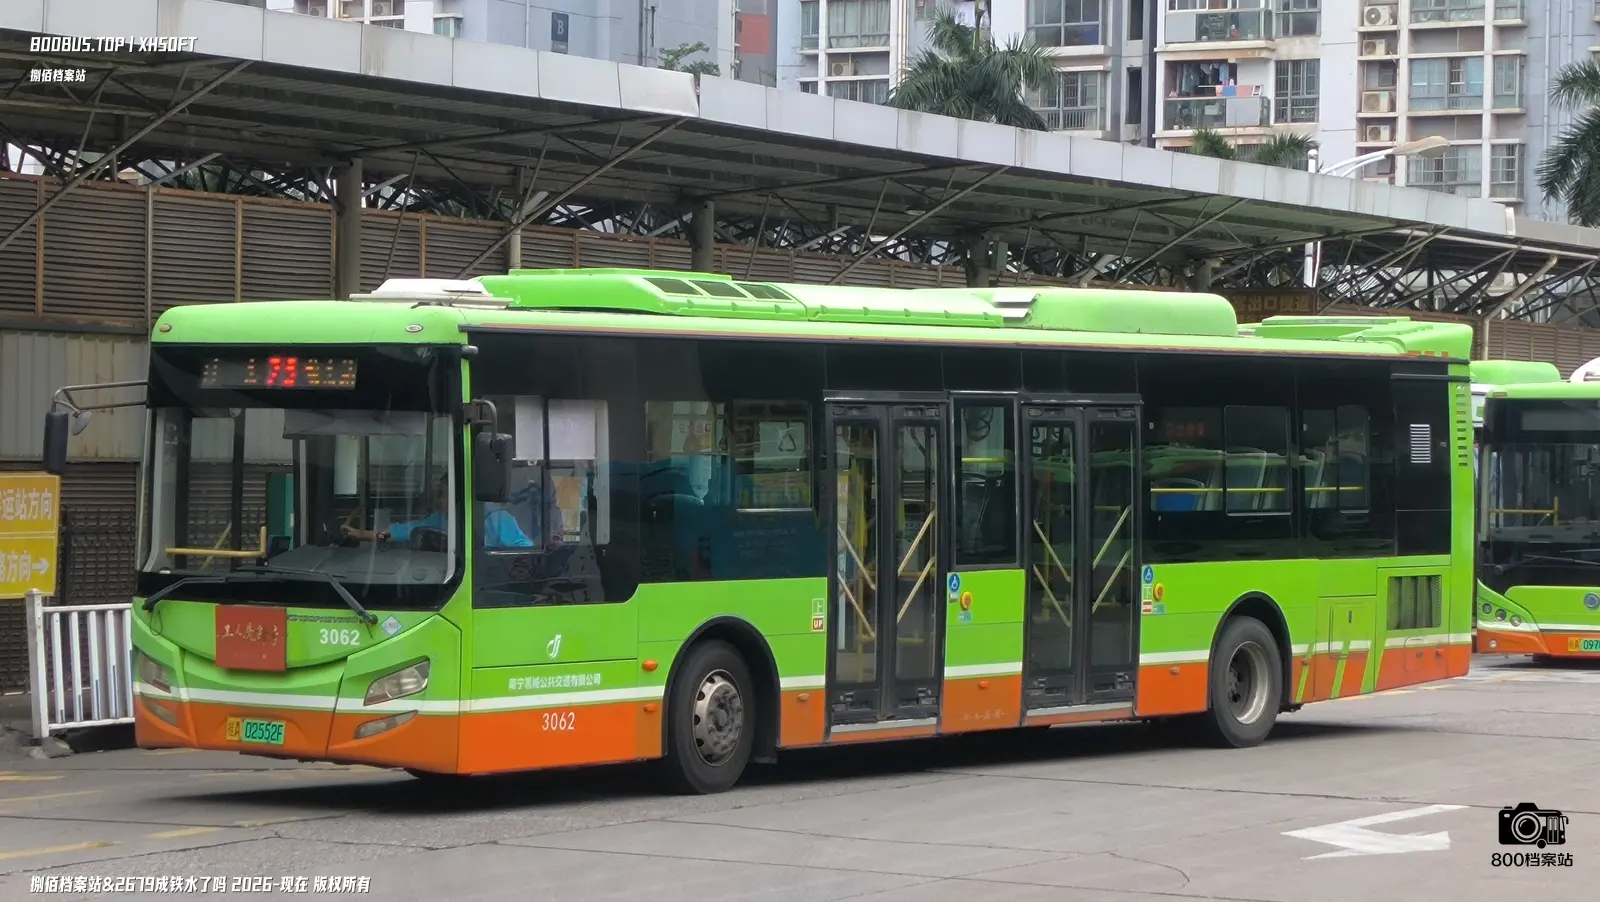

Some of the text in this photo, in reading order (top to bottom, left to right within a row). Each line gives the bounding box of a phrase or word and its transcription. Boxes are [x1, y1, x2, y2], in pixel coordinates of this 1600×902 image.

[268, 357, 298, 385] 73
[0, 488, 52, 520] 运站方向
[813, 601, 823, 615] 上
[813, 619, 823, 628] UP
[319, 628, 361, 646] 3062
[542, 712, 575, 731] 3062
